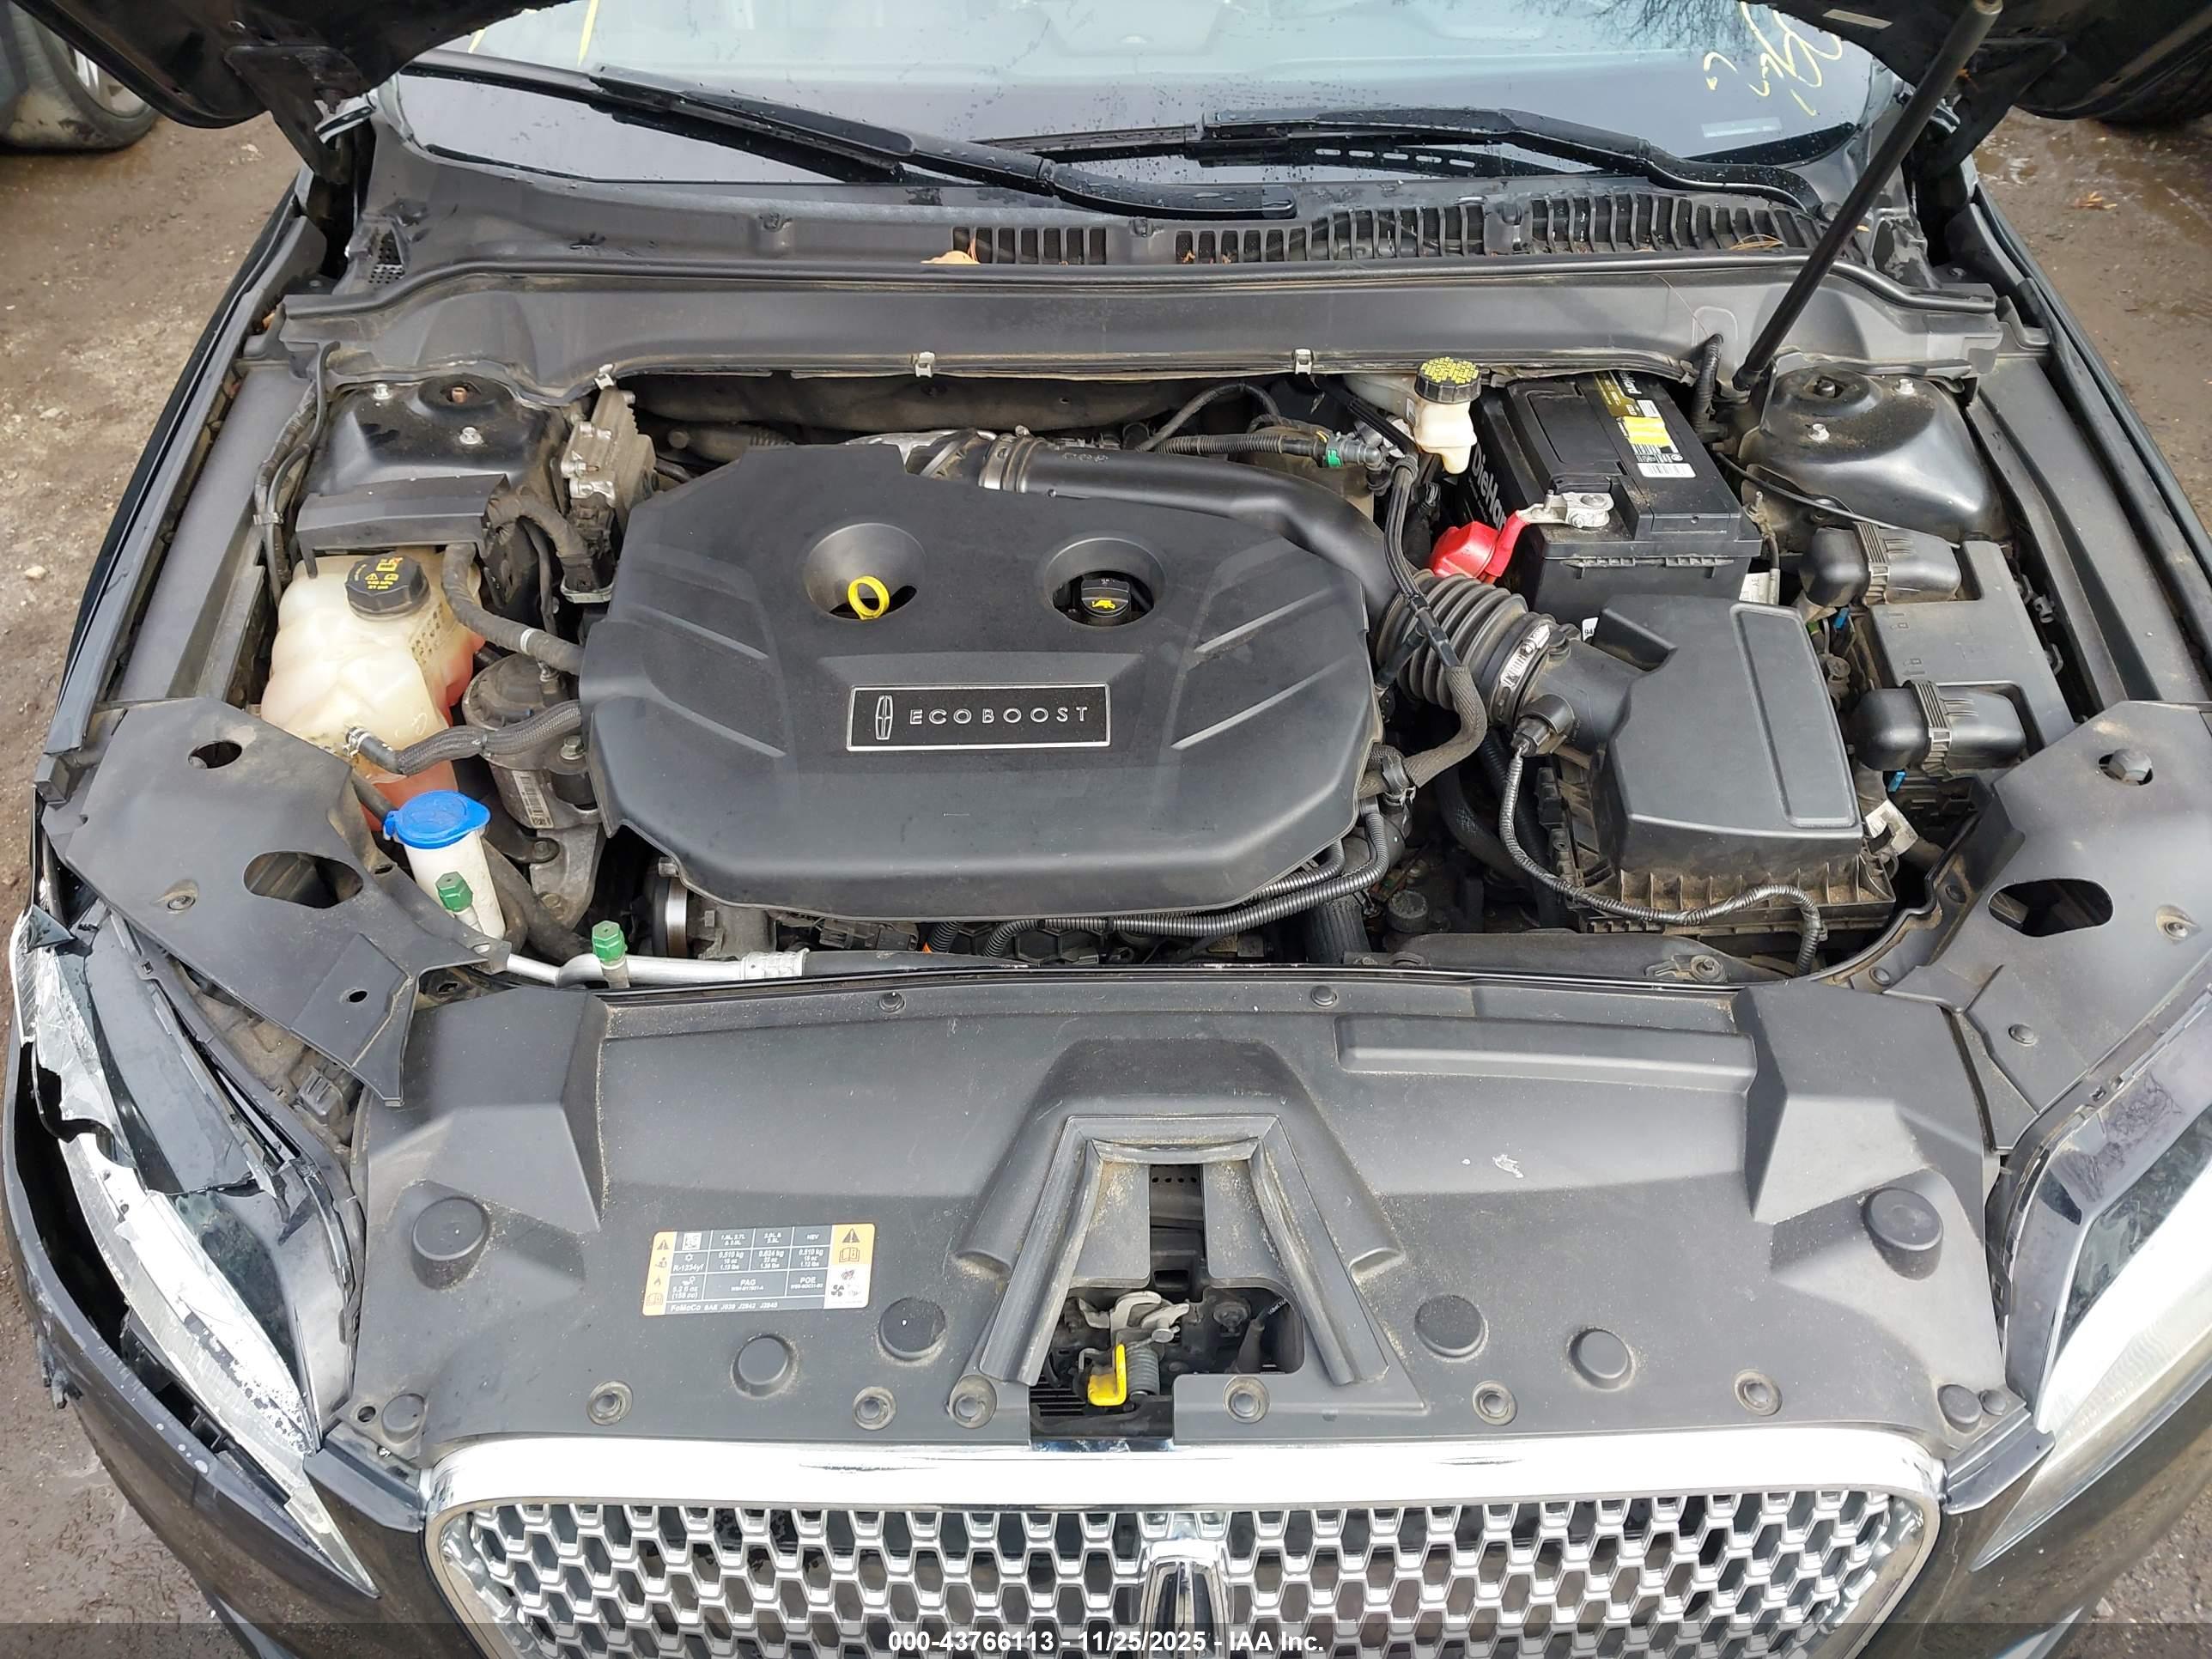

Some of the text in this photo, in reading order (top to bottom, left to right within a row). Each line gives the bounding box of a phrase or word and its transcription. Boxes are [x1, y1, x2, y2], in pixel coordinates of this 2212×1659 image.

[1626, 404, 1637, 416] GOLD
[1472, 441, 1507, 532] DieHar
[909, 706, 1088, 725] ECOBOOST
[671, 1304, 701, 1312] FoMoCo
